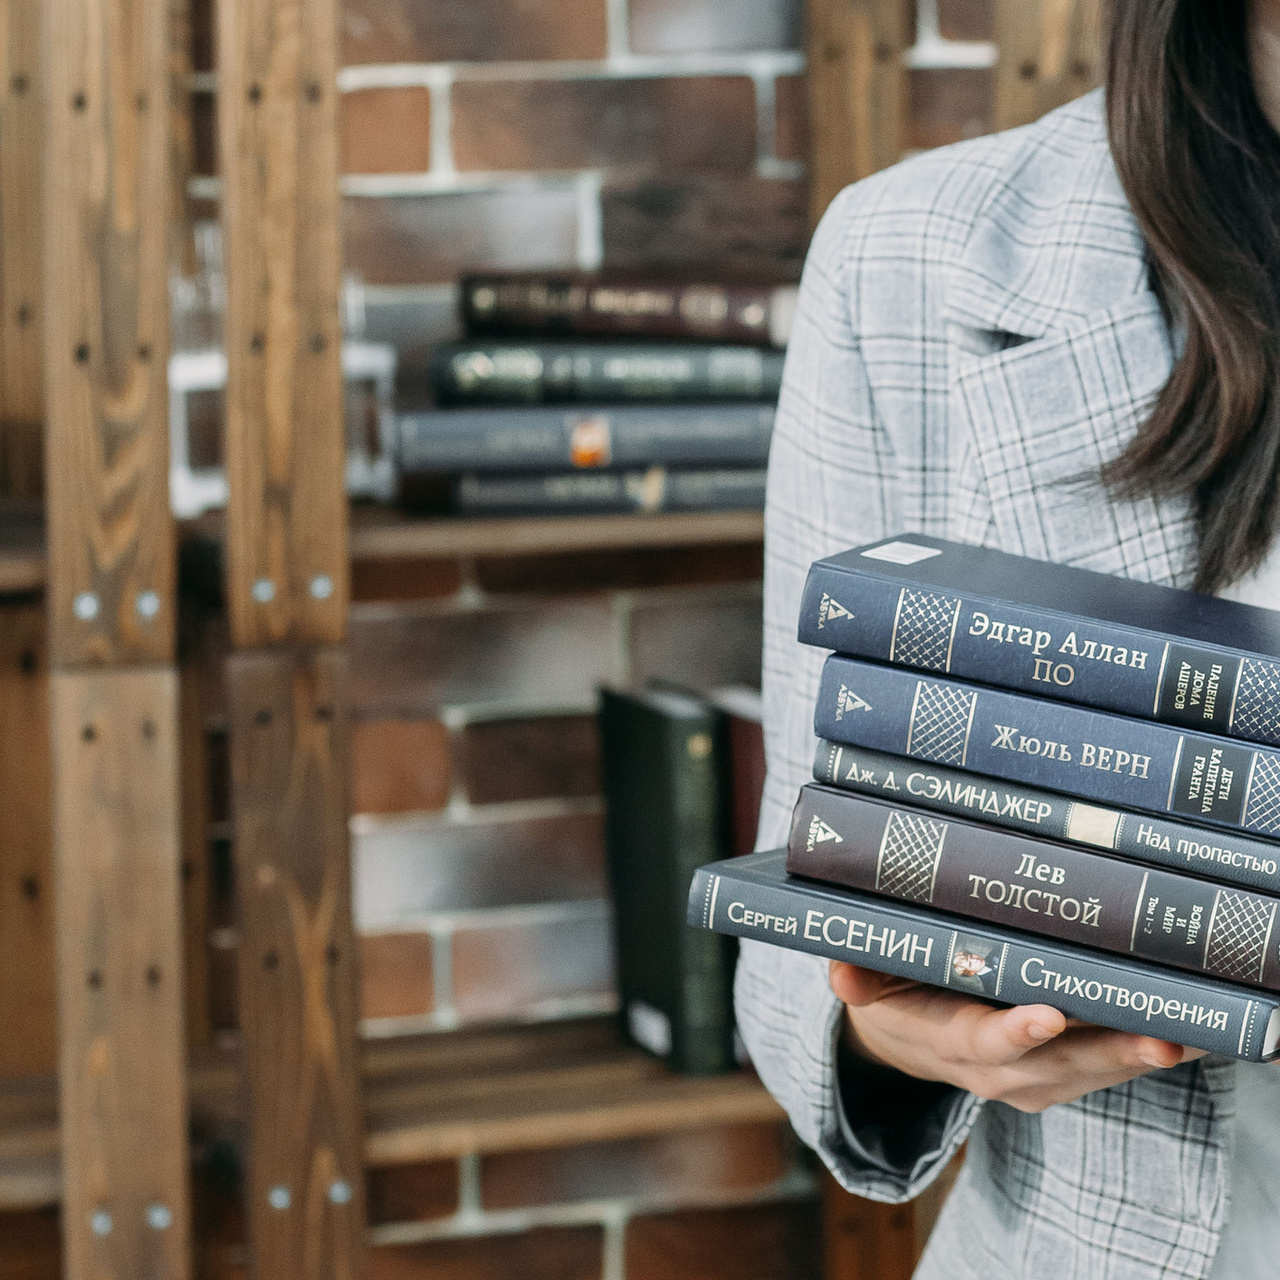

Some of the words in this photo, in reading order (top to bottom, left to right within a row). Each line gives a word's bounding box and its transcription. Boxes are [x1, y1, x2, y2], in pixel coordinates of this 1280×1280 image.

[817, 592, 830, 630] АЗБУКА
[969, 612, 1051, 654] Эдгар
[1058, 632, 1148, 670] Аллан
[1032, 658, 1075, 686] ПО
[1174, 661, 1191, 710] АШЕРОВ
[1190, 670, 1205, 706] ДОМА
[1203, 664, 1222, 720] ПАДЕНИЕ
[835, 683, 848, 722] АЗБУКА
[991, 724, 1072, 762] Жюль
[1080, 743, 1151, 780] ВЕРН
[882, 771, 901, 791] Д.
[906, 772, 1052, 824] СЭЛИНДЖЕР
[1188, 755, 1206, 800] ГРАНТА
[1201, 748, 1223, 813] КАПИТАНА
[1218, 767, 1234, 801] ДЕТИ
[806, 814, 820, 852] АЗБУКА
[1136, 823, 1171, 853] Над
[1176, 839, 1277, 875] пропастью
[1014, 853, 1066, 885] Лев
[968, 874, 1102, 928] ТОЛСТОЙ
[1146, 897, 1159, 916] Том
[1162, 905, 1177, 934] МИР
[803, 909, 934, 967] ЕСЕНИН
[1176, 917, 1187, 929] И
[1186, 904, 1204, 946] ВОЙНА
[1020, 957, 1229, 1031] Стихотворения
